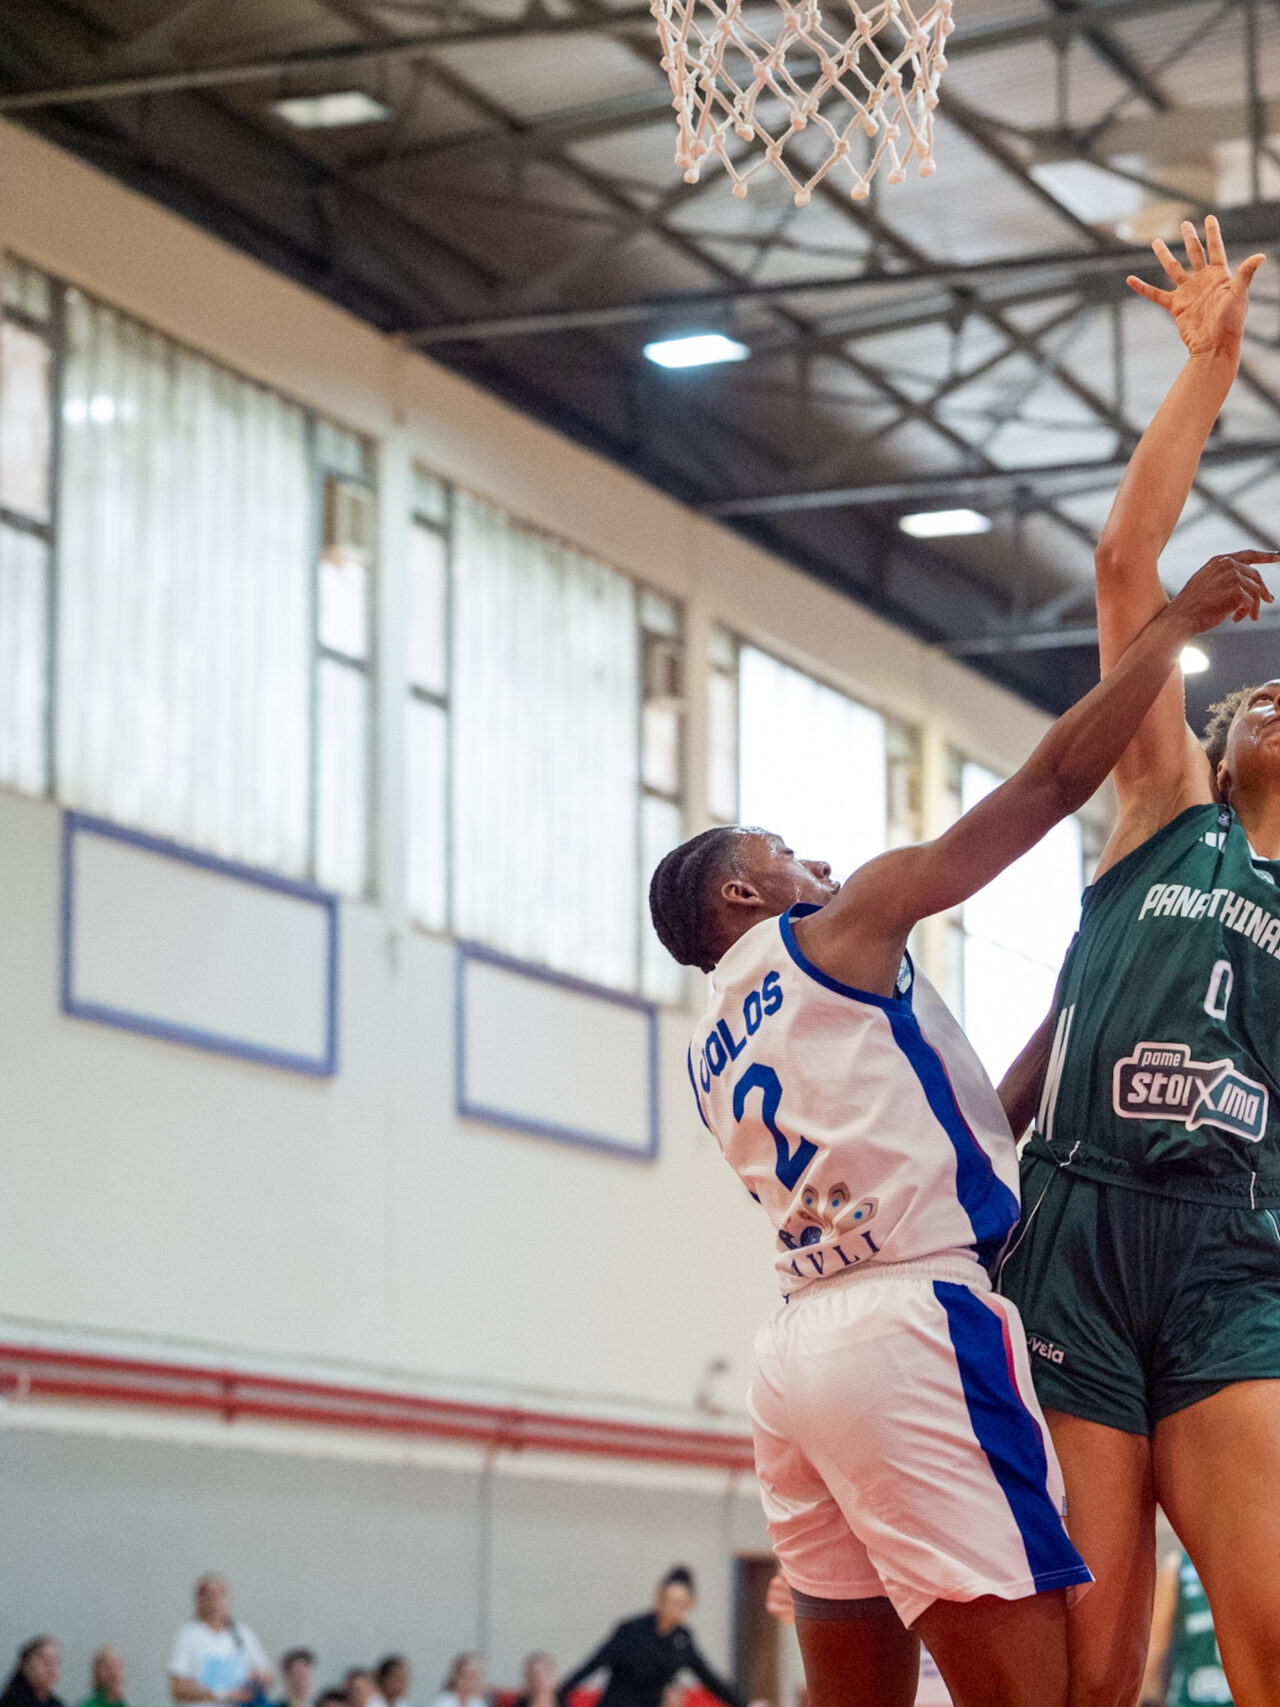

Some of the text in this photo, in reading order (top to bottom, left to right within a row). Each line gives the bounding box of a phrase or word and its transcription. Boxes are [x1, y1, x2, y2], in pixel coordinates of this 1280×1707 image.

[1203, 959, 1234, 1022] 0
[1140, 1050, 1183, 1068] pame
[732, 1061, 819, 1192] 2
